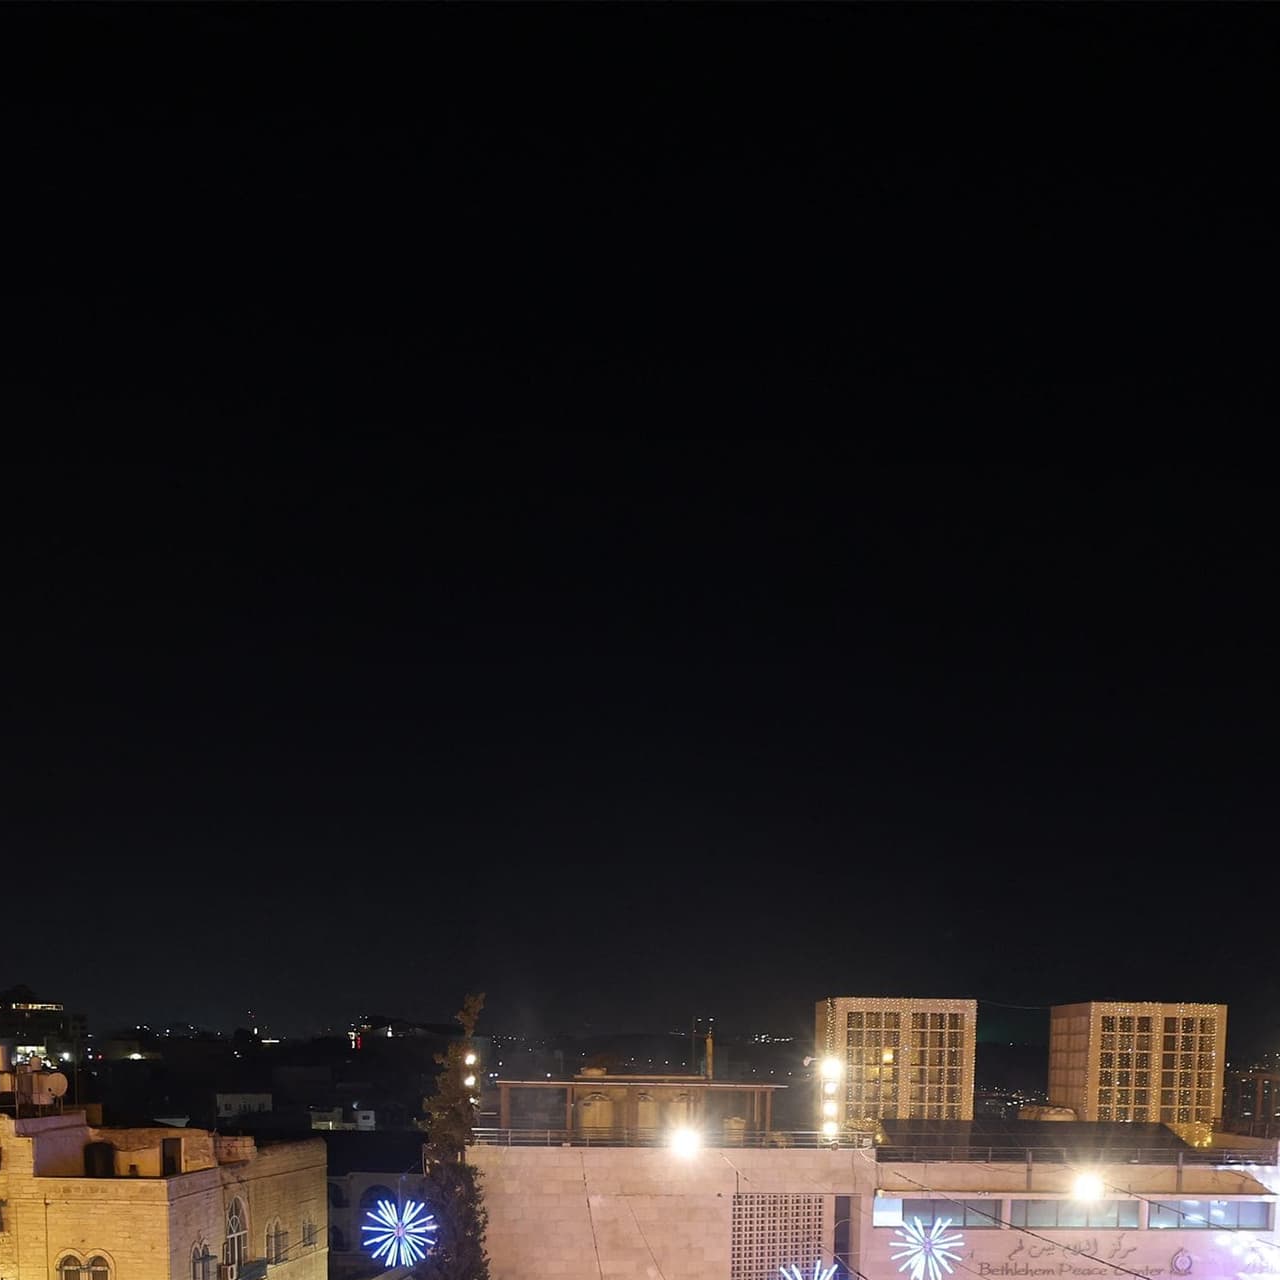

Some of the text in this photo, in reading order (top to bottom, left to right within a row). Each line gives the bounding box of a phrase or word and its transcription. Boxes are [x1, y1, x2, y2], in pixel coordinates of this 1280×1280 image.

[978, 1262, 1163, 1276] Bethlehem Peace Center
